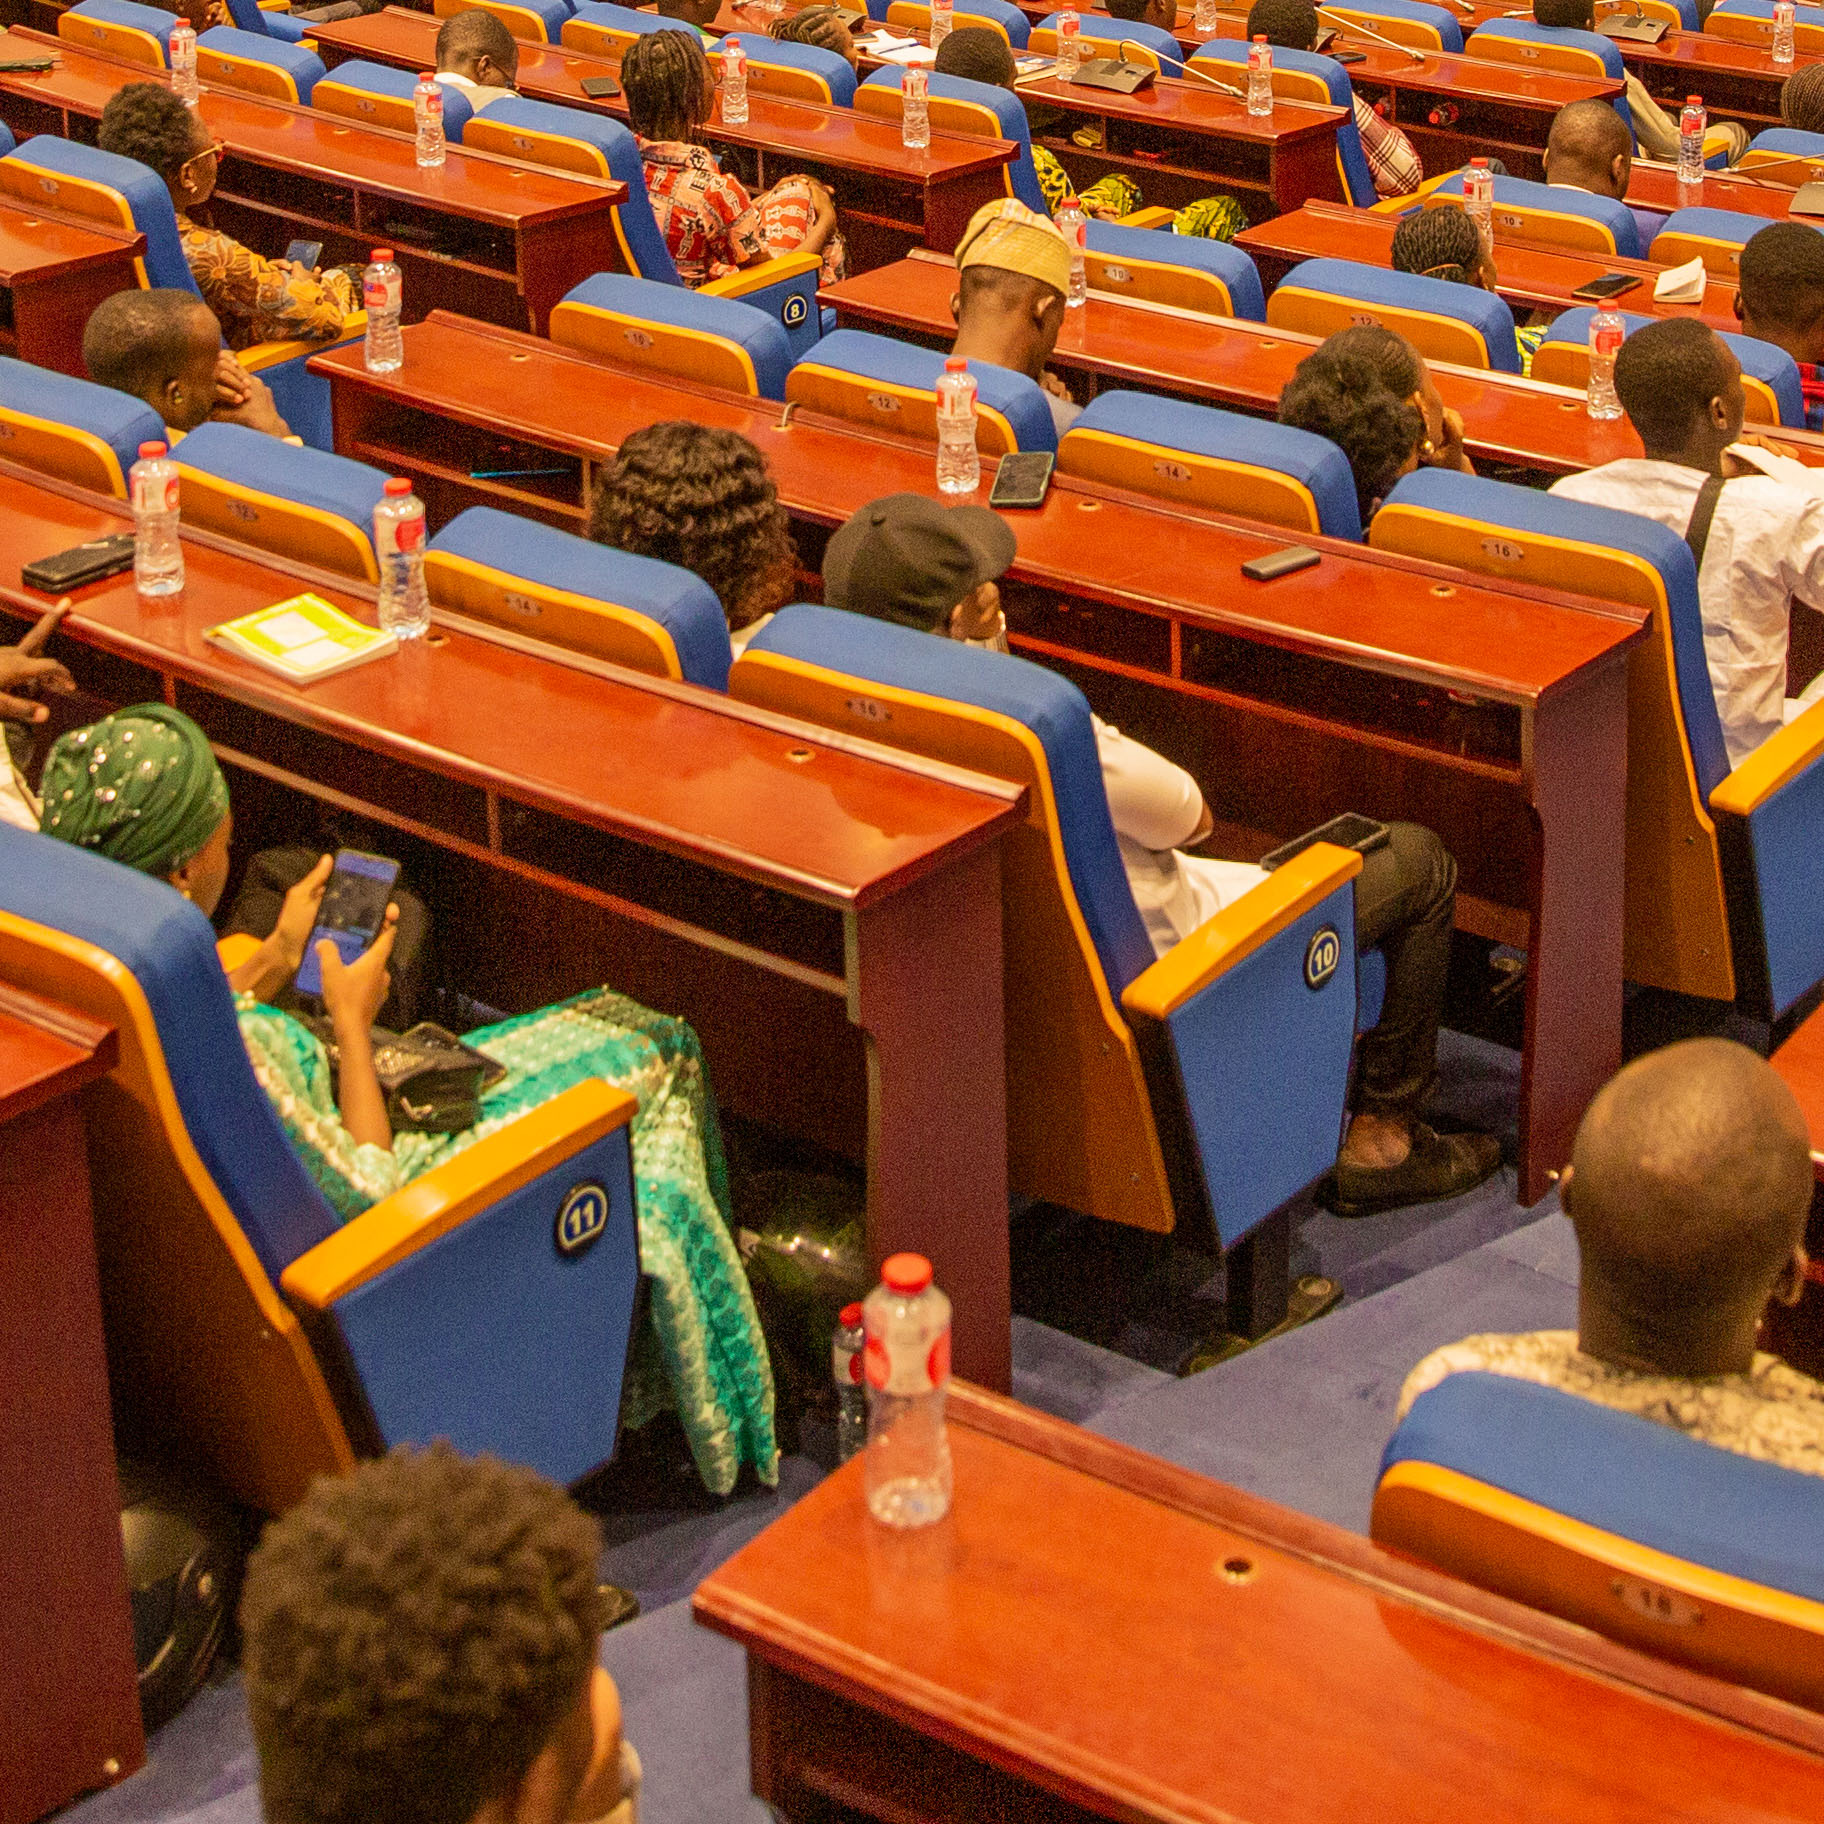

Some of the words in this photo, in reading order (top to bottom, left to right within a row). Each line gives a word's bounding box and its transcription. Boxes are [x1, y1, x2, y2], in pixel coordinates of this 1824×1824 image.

[1504, 216, 1515, 225] 10
[1113, 268, 1124, 279] 10
[790, 303, 800, 318] 8
[879, 396, 890, 408] 12
[1165, 466, 1179, 478] 14
[1494, 544, 1510, 557] 16
[1315, 943, 1333, 971] 10
[568, 1200, 596, 1234] 11
